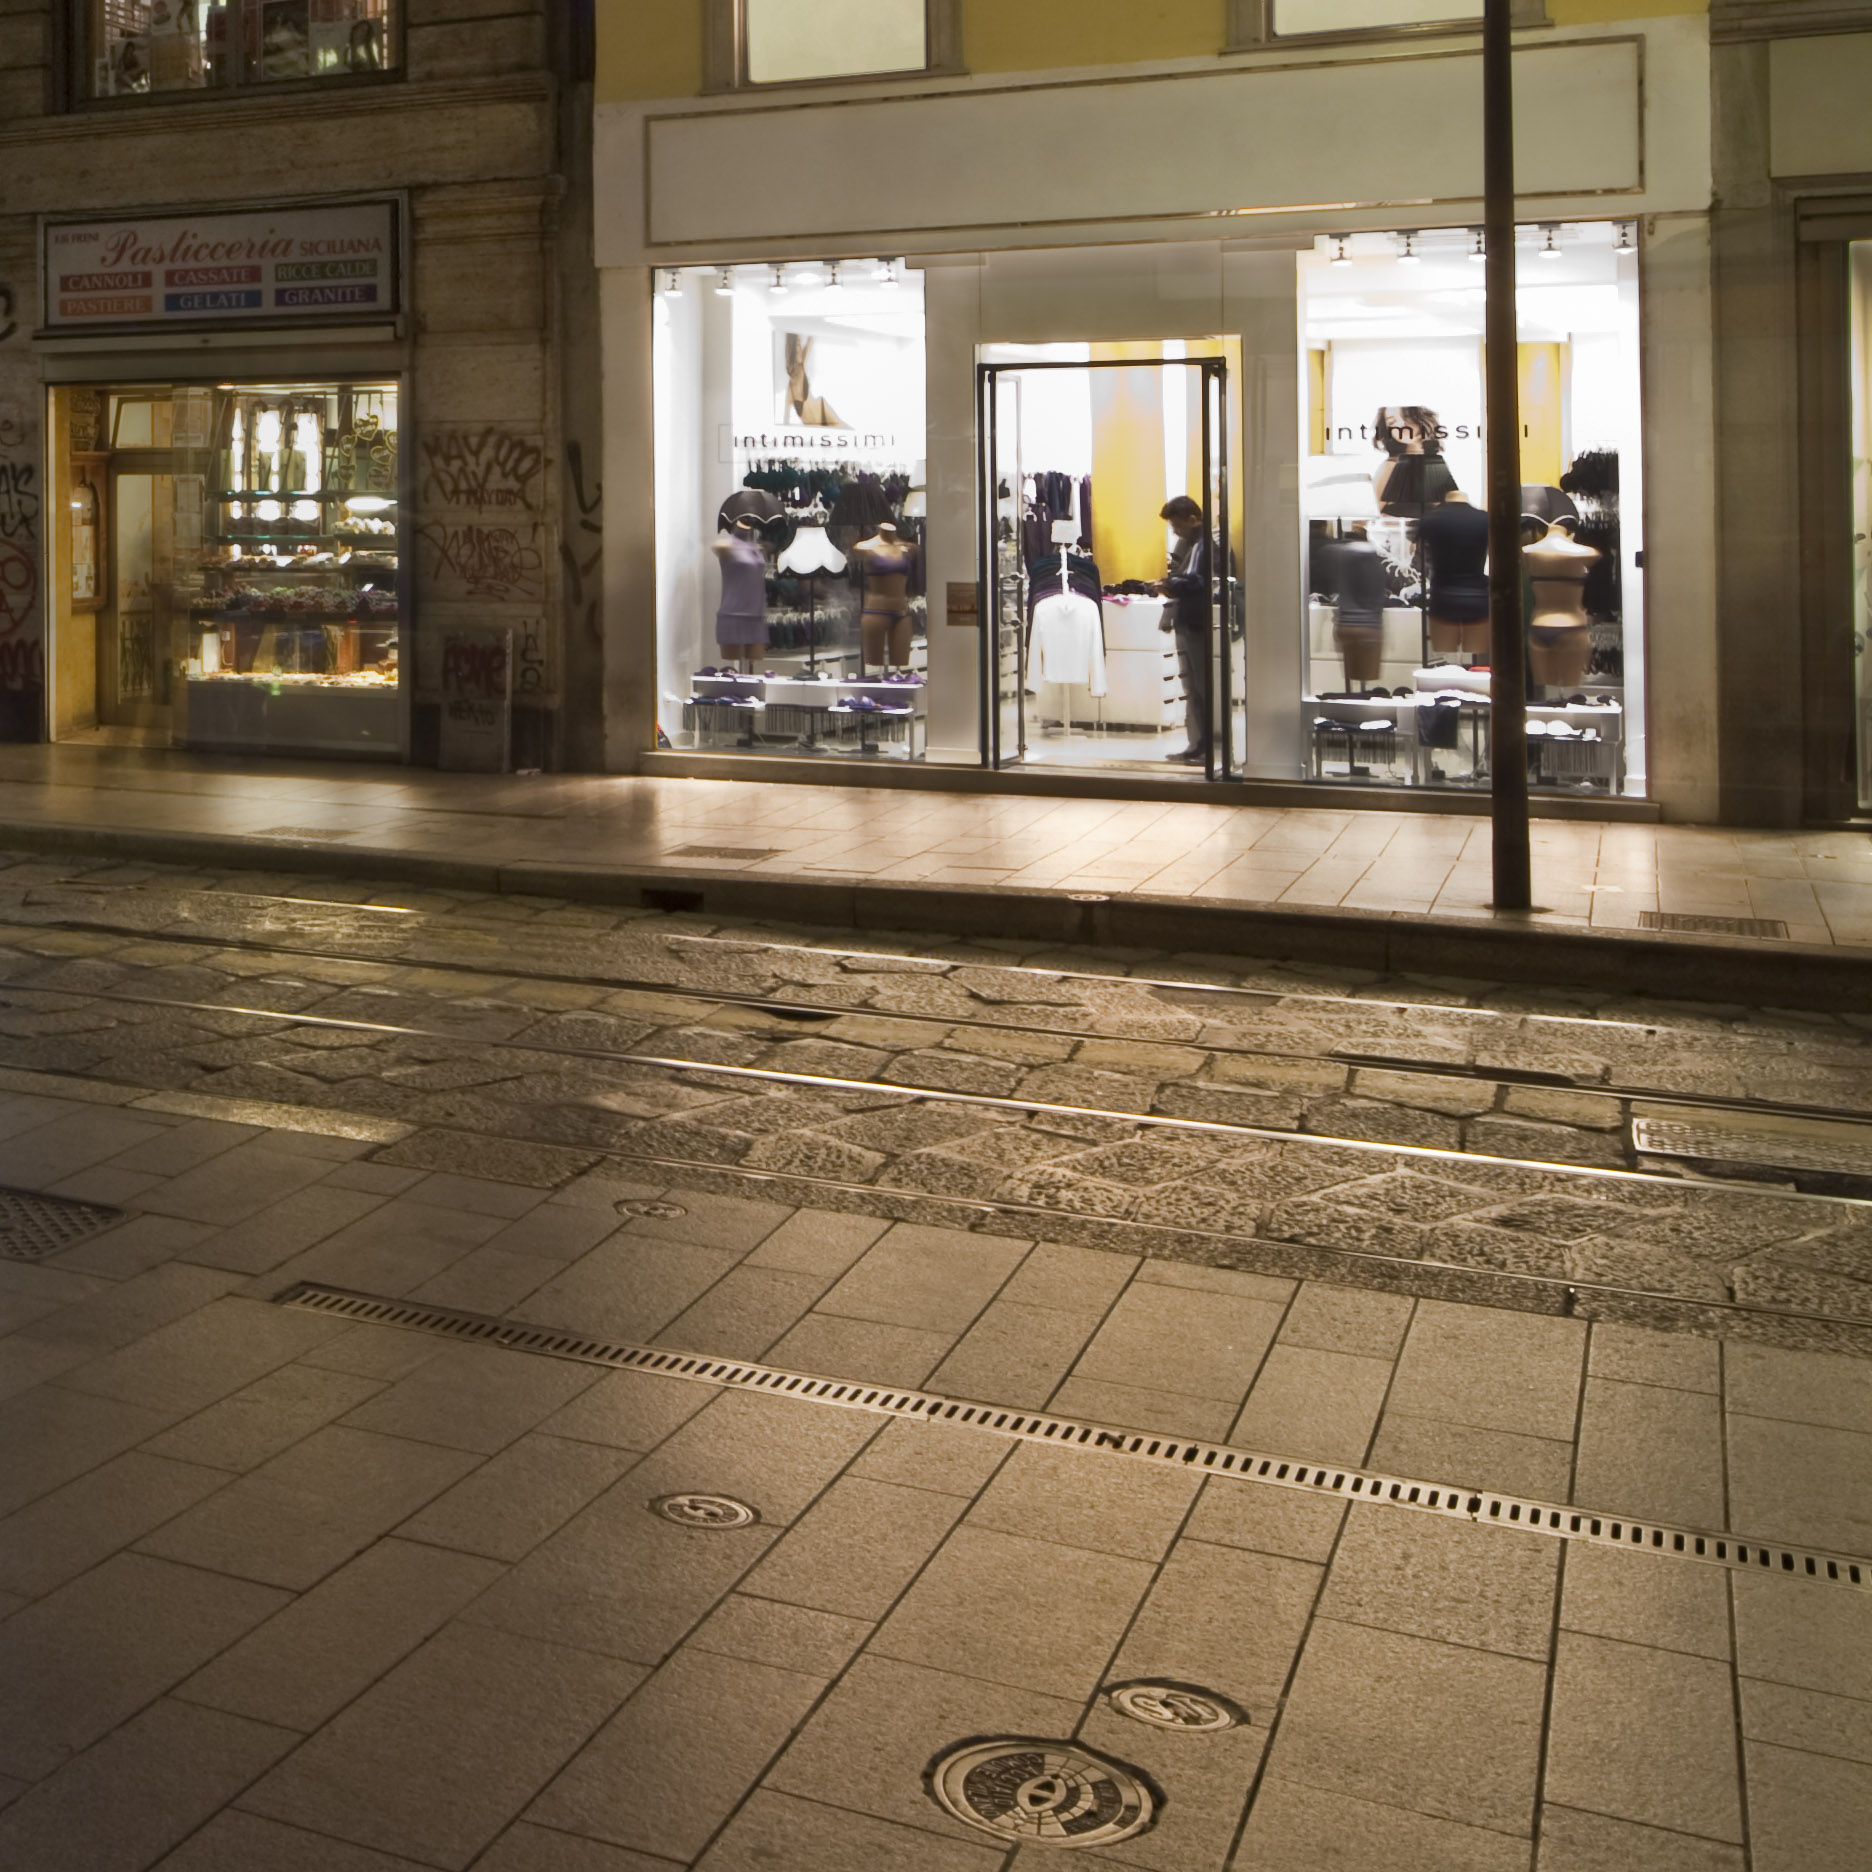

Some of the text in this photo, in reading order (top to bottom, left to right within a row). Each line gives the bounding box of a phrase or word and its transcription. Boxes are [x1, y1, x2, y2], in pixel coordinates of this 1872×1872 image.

[100, 227, 383, 268] Pasticceria SICILIANA
[173, 268, 251, 285] CASSATE
[277, 260, 373, 280] RICCE CALDE
[68, 274, 143, 290] CANNOLI
[179, 292, 246, 309] GELATI
[284, 287, 366, 305] GRANITE
[66, 299, 145, 314] PASTIERE
[734, 433, 895, 448] intimissimi
[1326, 423, 1528, 441] intimissii
